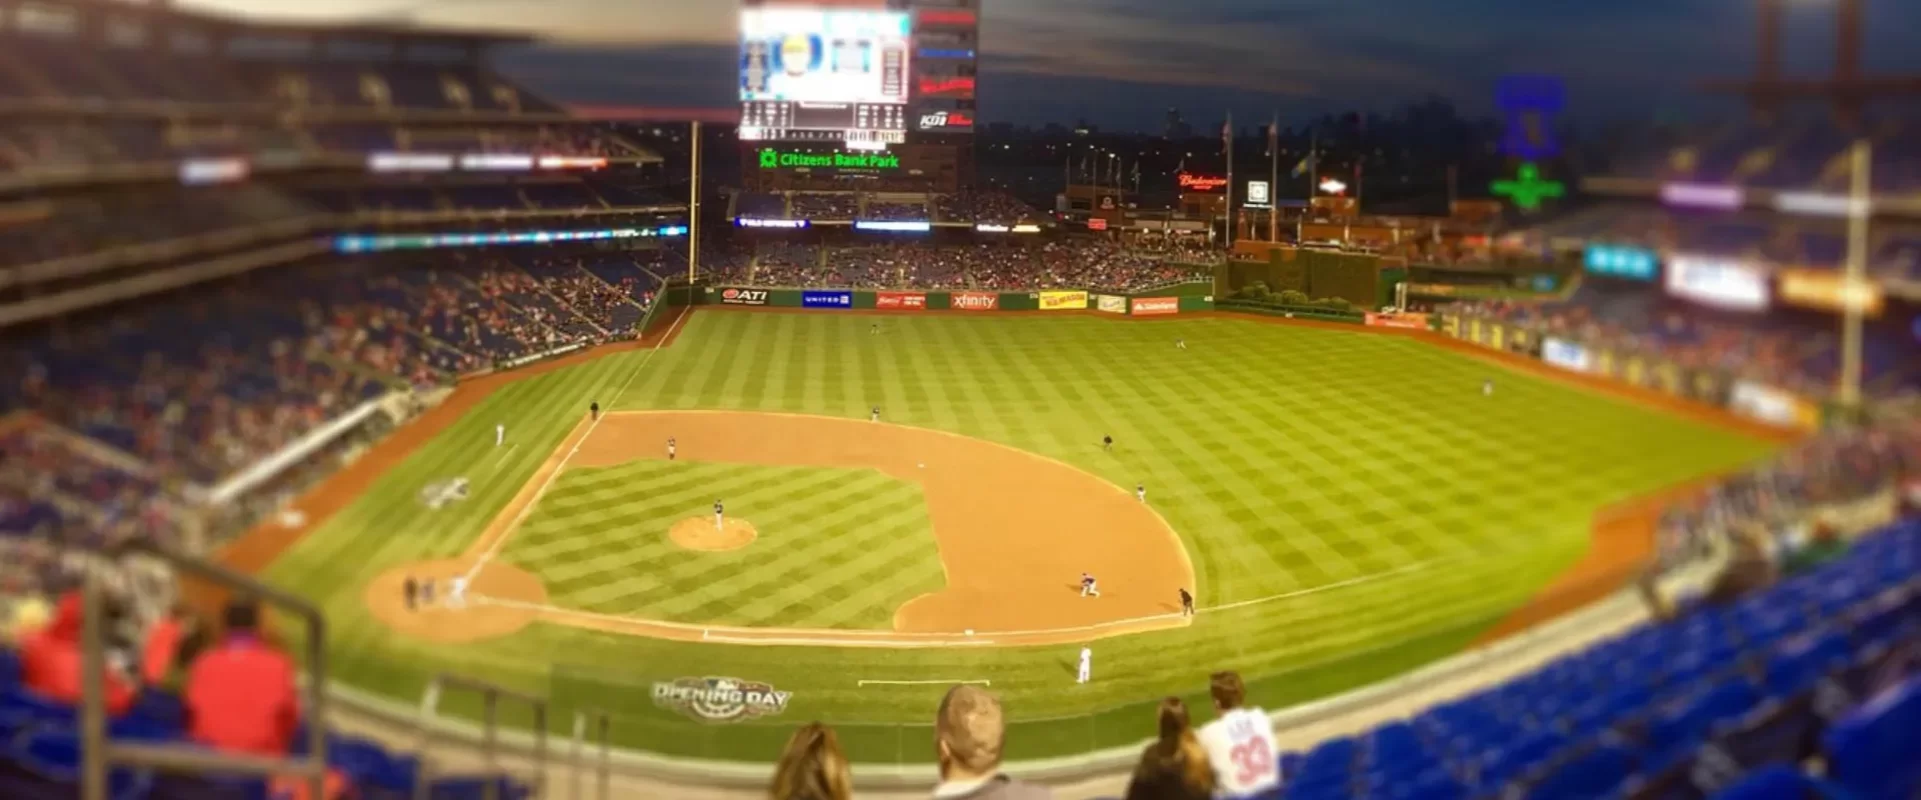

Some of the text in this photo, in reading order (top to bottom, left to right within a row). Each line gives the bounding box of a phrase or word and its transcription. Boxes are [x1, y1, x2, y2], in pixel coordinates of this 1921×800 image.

[780, 153, 899, 168] Citizens Bank Park
[738, 290, 768, 300] ATI
[953, 294, 996, 309] xfinity
[652, 682, 791, 706] OPENING DAY
